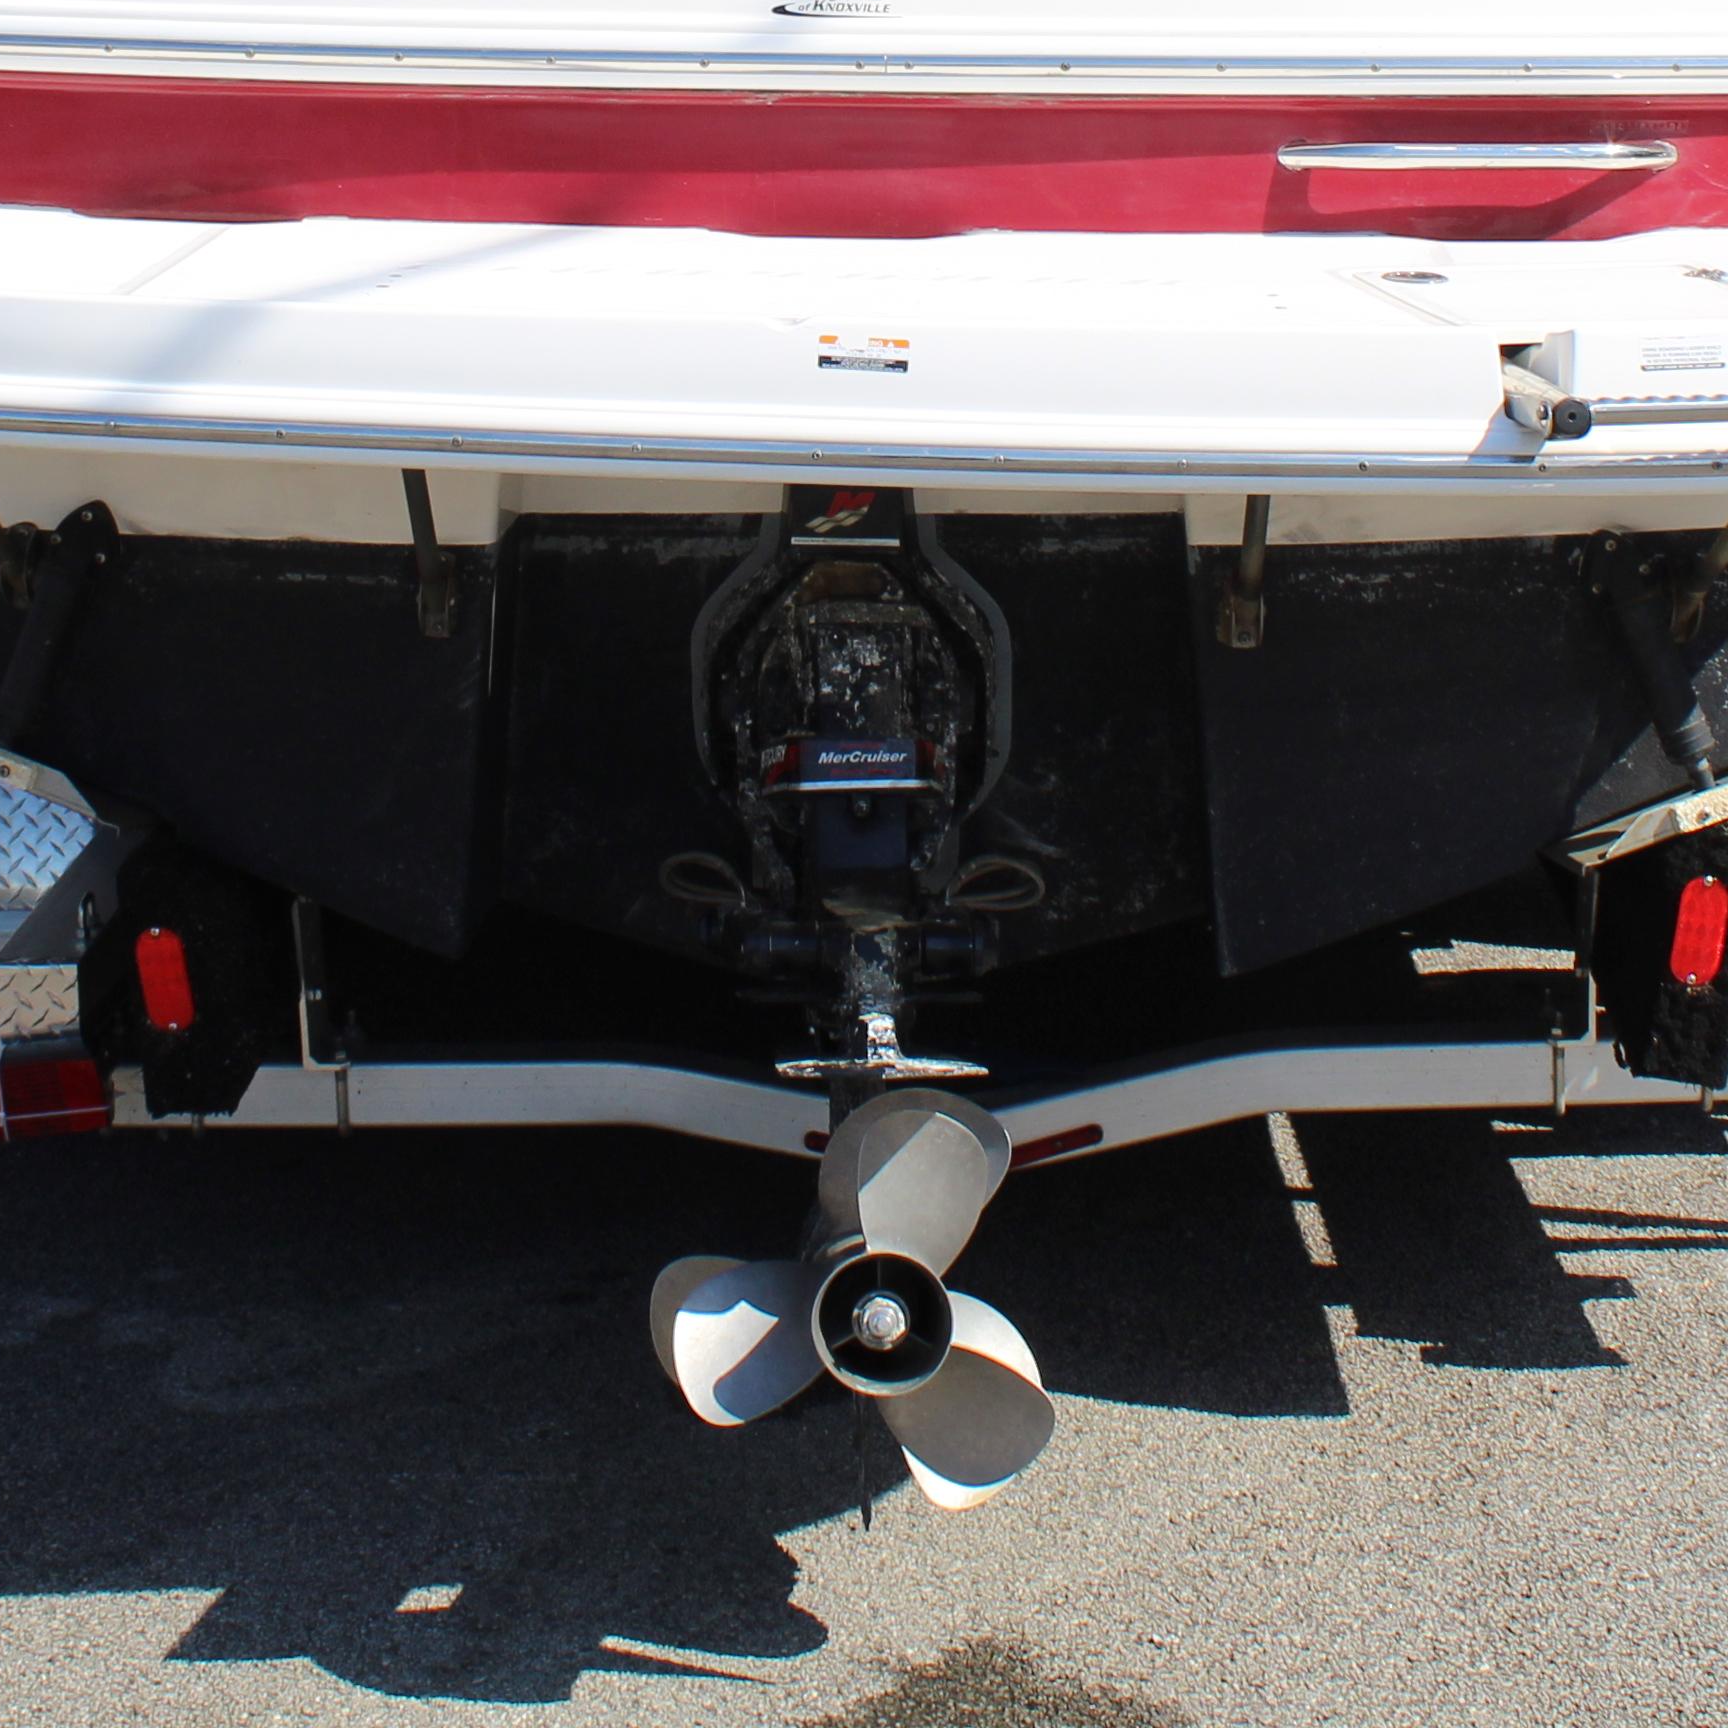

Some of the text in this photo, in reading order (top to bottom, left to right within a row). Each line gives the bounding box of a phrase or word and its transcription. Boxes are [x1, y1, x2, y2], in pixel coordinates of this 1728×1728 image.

[798, 0, 890, 13] of KNOXVILLE
[818, 750, 908, 765] MerCruiser
